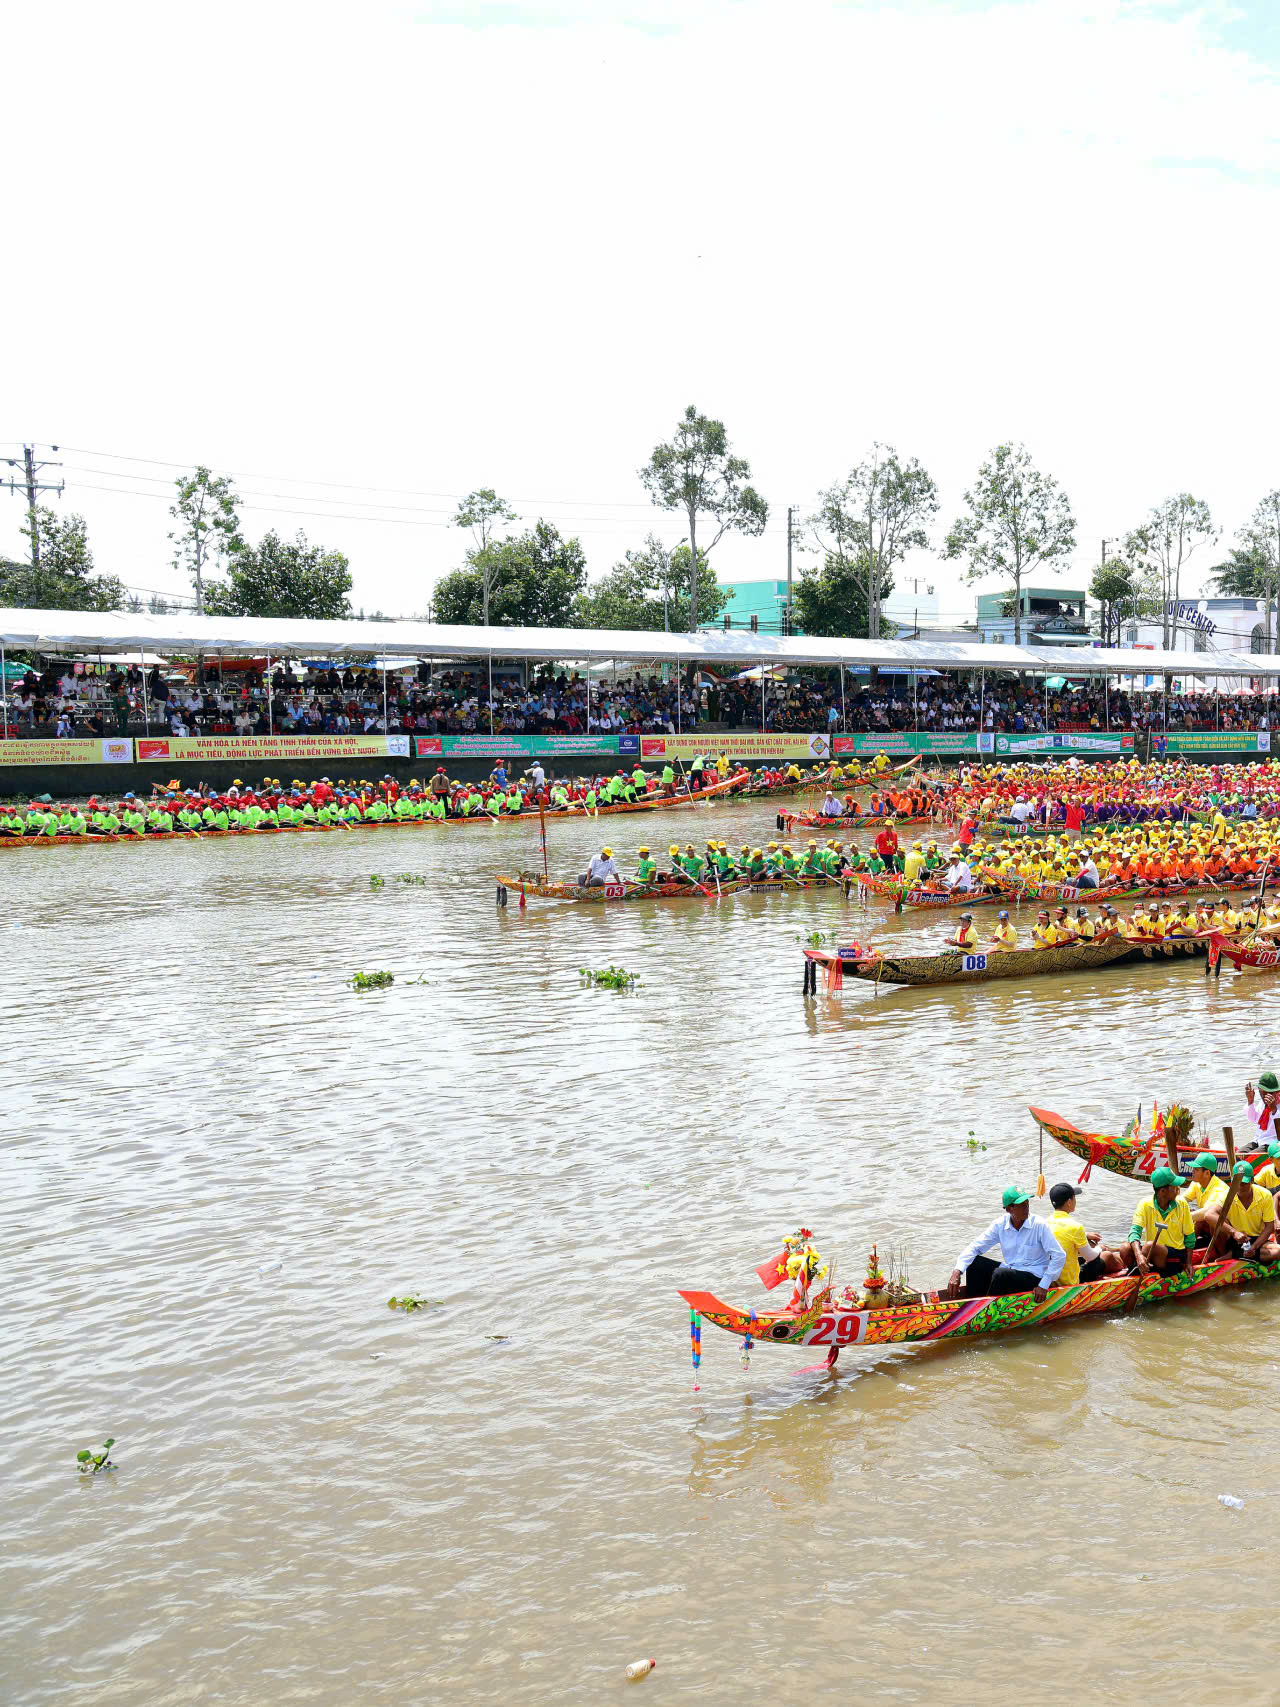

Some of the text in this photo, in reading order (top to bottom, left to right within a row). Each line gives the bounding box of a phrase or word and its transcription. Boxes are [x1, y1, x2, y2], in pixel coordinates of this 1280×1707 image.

[1186, 606, 1217, 637] CENTRE
[1016, 824, 1027, 832] 19
[605, 887, 624, 897] 03
[1063, 888, 1076, 898] 01
[966, 955, 986, 971] 08
[1259, 952, 1277, 964] 06
[808, 1315, 860, 1346] 29
